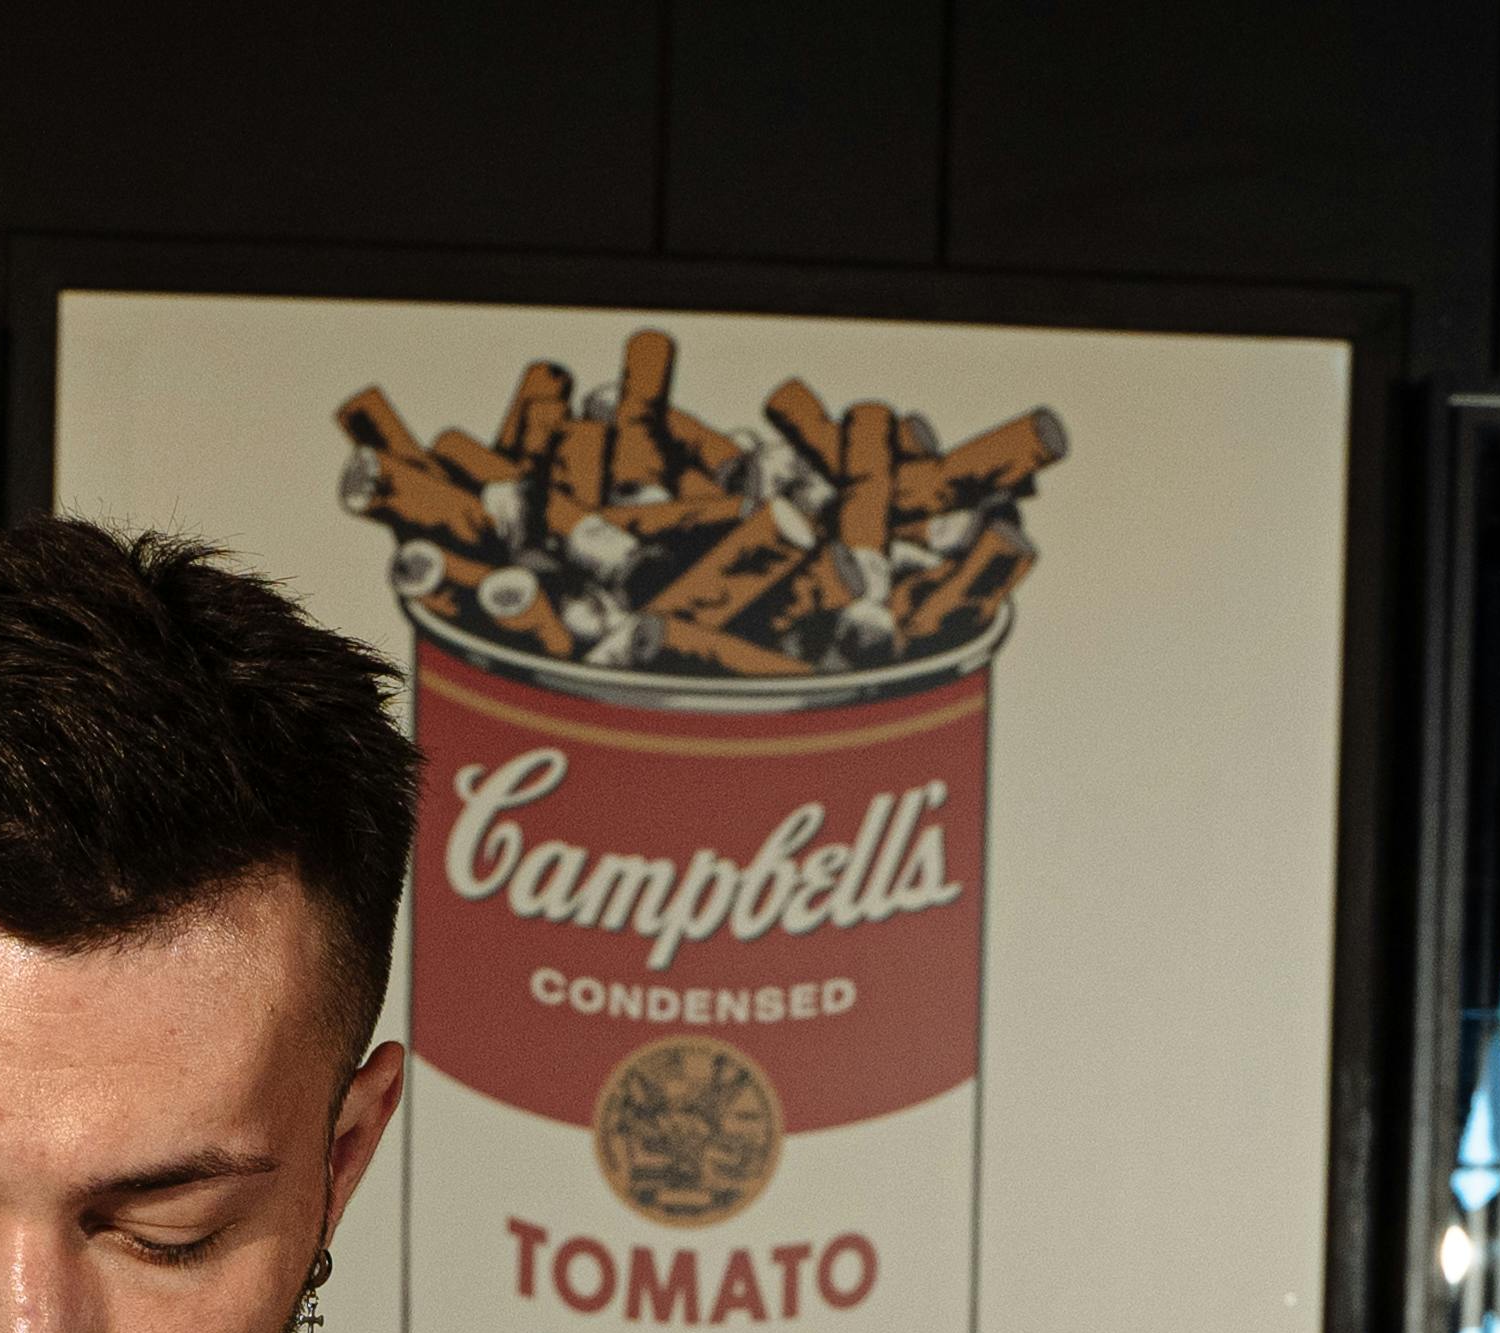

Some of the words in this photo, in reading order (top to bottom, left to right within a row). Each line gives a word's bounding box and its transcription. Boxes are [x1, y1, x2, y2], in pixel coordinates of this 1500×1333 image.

[446, 748, 962, 970] Campbell's
[530, 967, 857, 1024] CONDENSED
[506, 1216, 878, 1326] TOMATO
